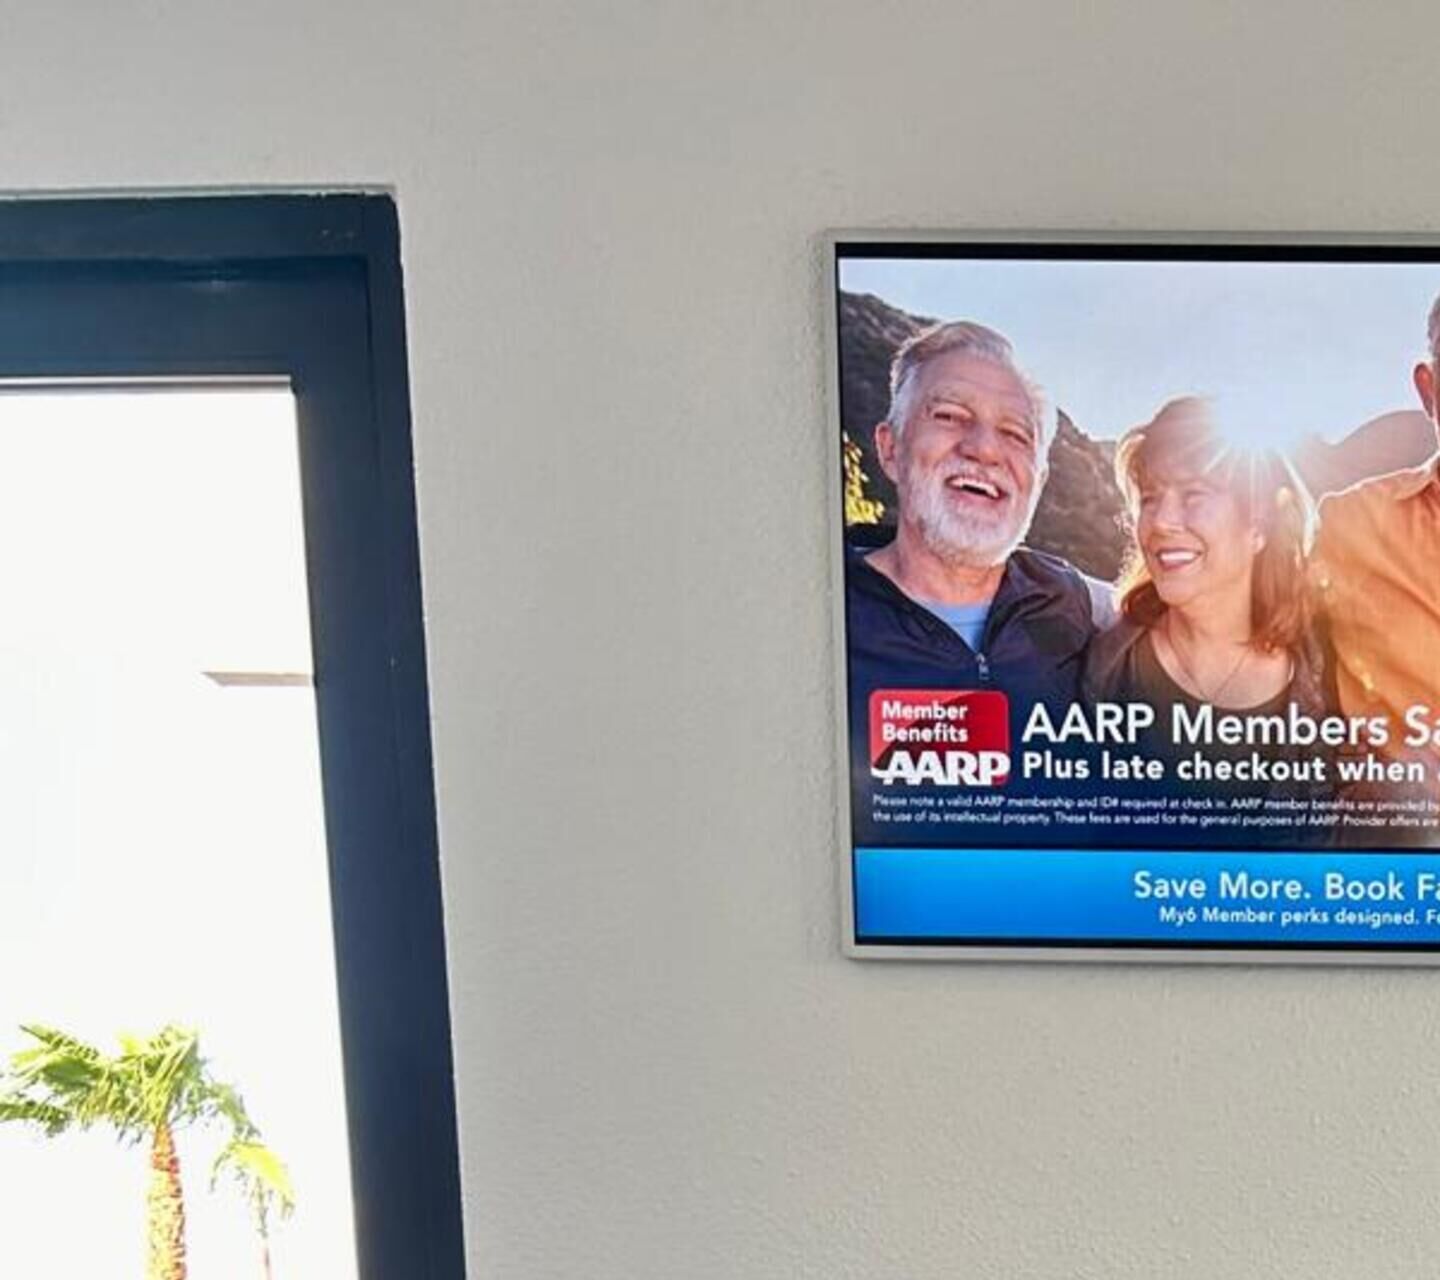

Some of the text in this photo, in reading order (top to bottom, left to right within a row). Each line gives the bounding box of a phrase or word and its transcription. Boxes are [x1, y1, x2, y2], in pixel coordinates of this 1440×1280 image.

[881, 700, 968, 720] Member
[881, 723, 968, 743] Benefits
[1022, 703, 1154, 743] AARP
[1173, 703, 1389, 746] Members
[871, 750, 1011, 786] AARP
[1023, 752, 1090, 780] Plus
[1102, 752, 1164, 780] late
[1177, 752, 1326, 782] checkout
[1338, 754, 1424, 782] when
[873, 794, 907, 806] Please
[910, 795, 934, 806] note
[947, 796, 972, 807] valid
[974, 797, 1004, 807] AARP
[1007, 797, 1075, 809] membership
[1077, 797, 1098, 808] and
[1121, 798, 1167, 811] required
[1170, 798, 1180, 808] at
[1182, 798, 1212, 809] check
[1264, 799, 1309, 809] member
[1313, 799, 1354, 810] benefits
[1358, 801, 1375, 810] are
[1377, 800, 1427, 812] provided
[1428, 800, 1440, 813] by
[873, 811, 890, 821] the
[893, 813, 912, 822] use
[914, 812, 926, 822] of
[928, 812, 941, 822] its
[943, 811, 1001, 822] intellectual
[1054, 812, 1087, 823] These
[1089, 812, 1111, 823] fees
[1114, 814, 1131, 824] are
[1133, 813, 1160, 824] used
[1161, 813, 1177, 824] for
[1180, 813, 1198, 824] the
[1200, 813, 1241, 827] general
[1243, 815, 1292, 827] purposes
[1295, 815, 1306, 826] of
[1343, 815, 1389, 826] Provider
[1390, 815, 1419, 826] offers
[1422, 818, 1438, 826] are
[1133, 871, 1206, 900] Save
[1219, 872, 1311, 900] More.
[1325, 873, 1404, 901] Book
[1159, 907, 1197, 926] My6
[1203, 907, 1275, 923] Member
[1281, 908, 1329, 927] perks
[1334, 908, 1418, 928] designed.
